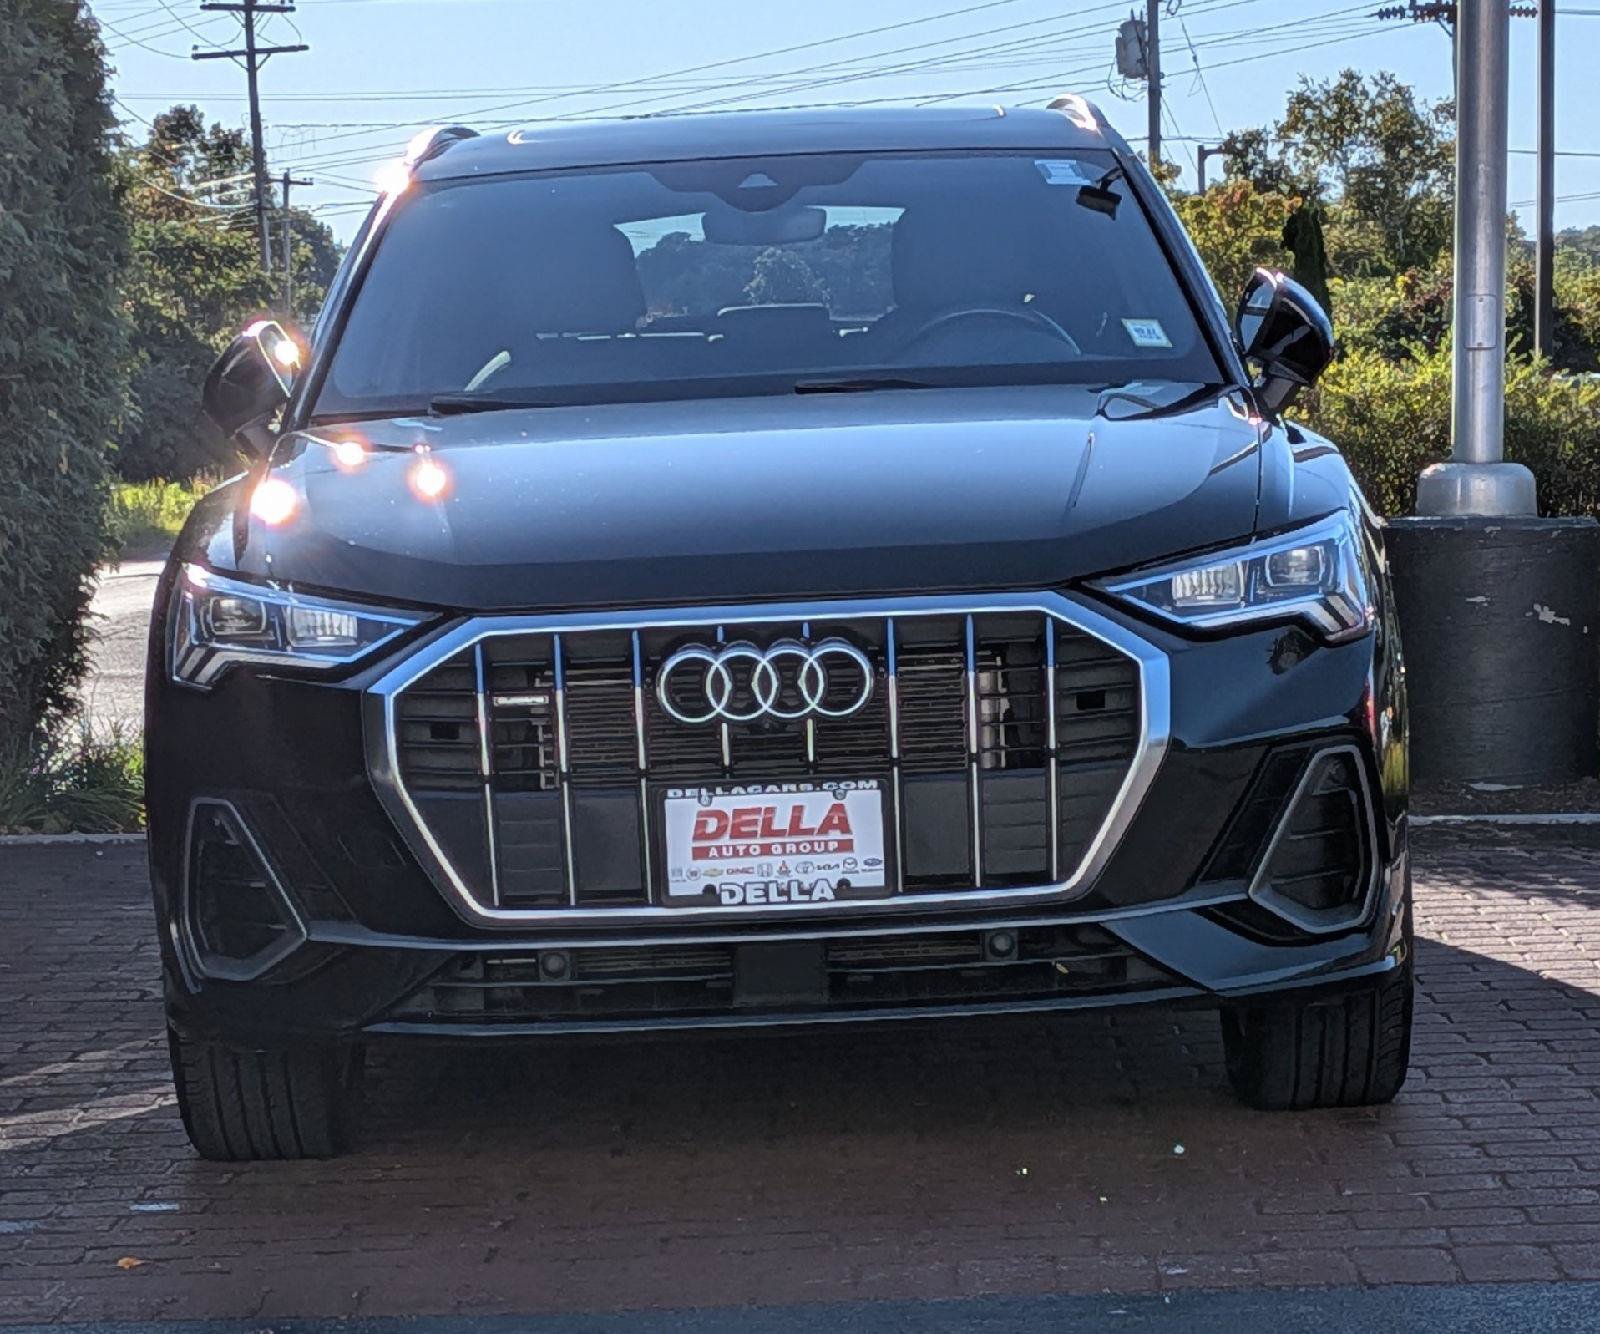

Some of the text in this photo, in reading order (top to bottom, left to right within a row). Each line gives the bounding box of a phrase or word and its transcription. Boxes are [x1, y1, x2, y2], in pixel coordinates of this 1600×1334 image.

[692, 803, 853, 842] DELLA
[709, 841, 839, 858] AUTO GROUP
[720, 879, 836, 905] DELLA
